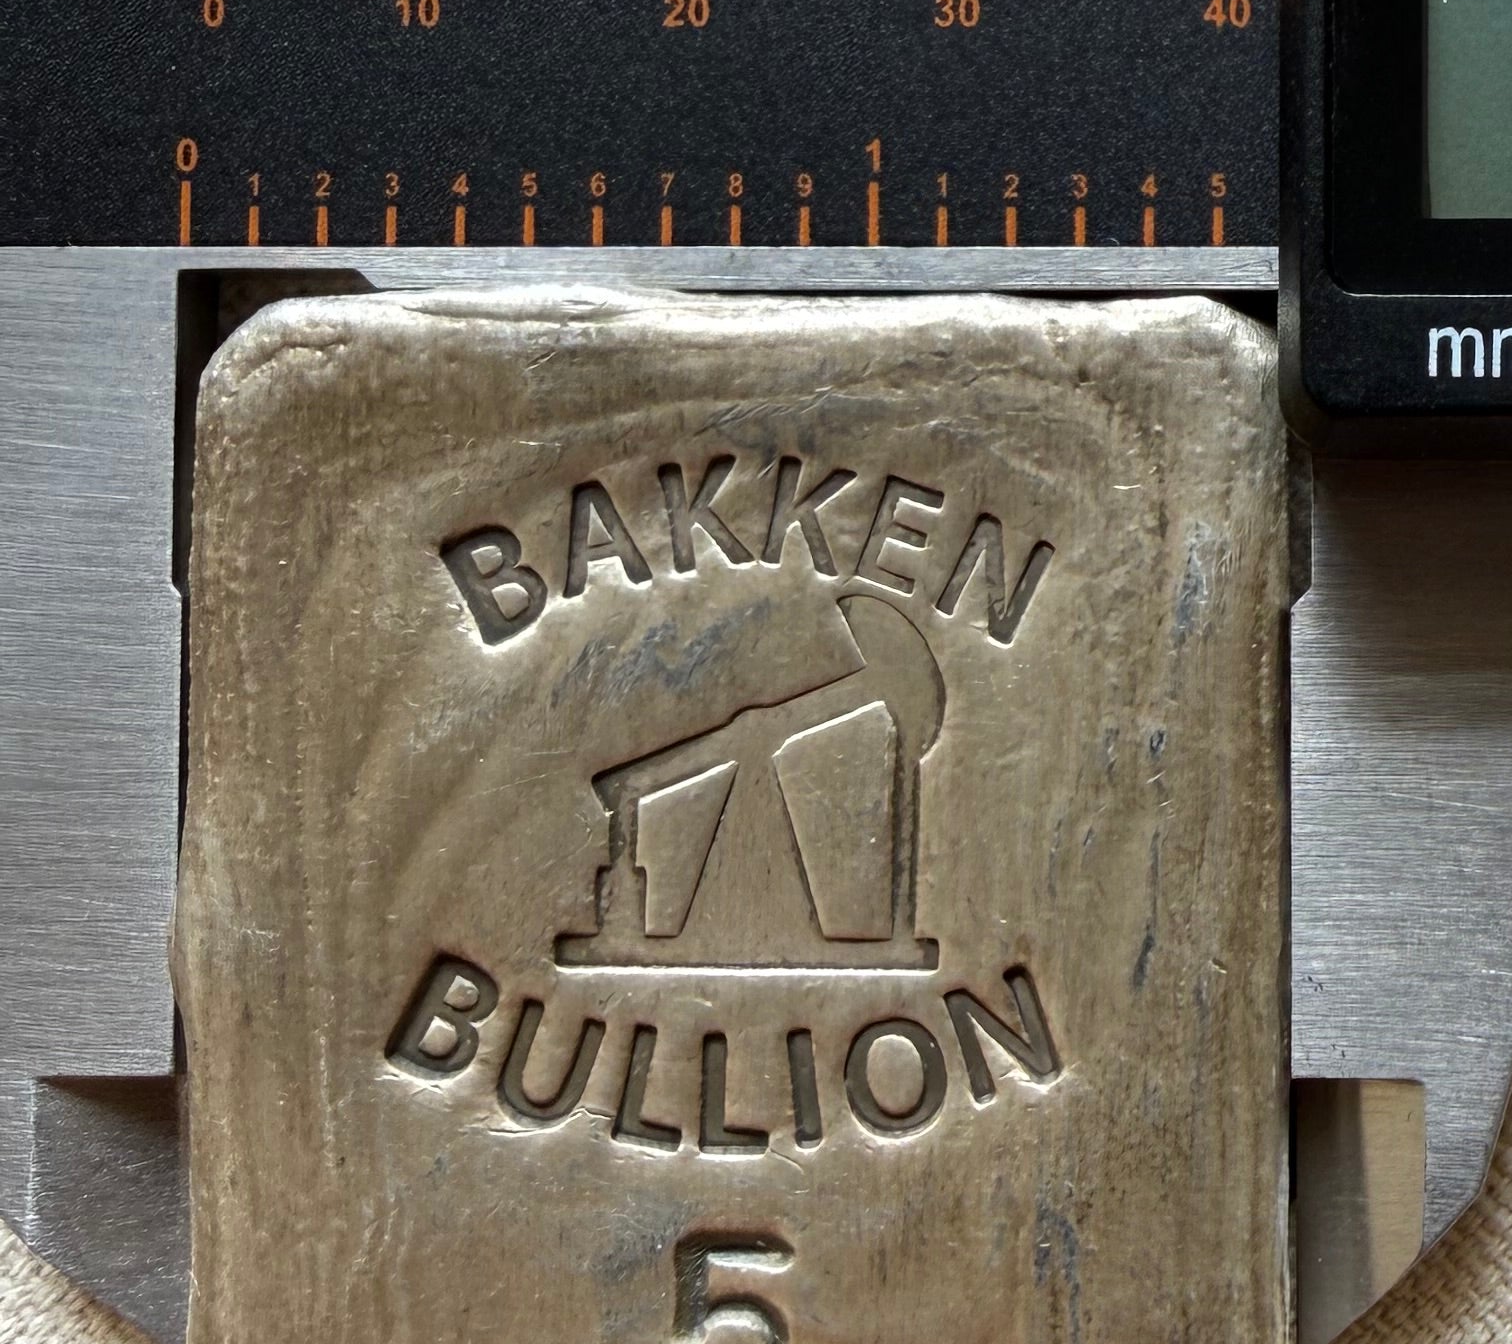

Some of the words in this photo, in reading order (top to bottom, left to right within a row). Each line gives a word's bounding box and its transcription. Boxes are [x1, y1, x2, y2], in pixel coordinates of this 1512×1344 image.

[175, 137, 198, 172] 0
[247, 172, 262, 197] 1
[314, 171, 332, 199] 2
[386, 172, 400, 197] 3
[451, 173, 469, 196] 4
[521, 171, 538, 197] 5
[588, 171, 607, 198] 6
[659, 172, 675, 197] 7
[727, 171, 744, 198] 8
[796, 174, 813, 198] 9
[866, 137, 882, 172] 1
[934, 172, 950, 197] 1
[1003, 174, 1018, 200] 2
[1073, 173, 1089, 200] 3
[1140, 175, 1158, 198] 4
[1210, 172, 1227, 198] 5
[439, 454, 1056, 648] BAKKEN
[384, 952, 1064, 1156] BULLION
